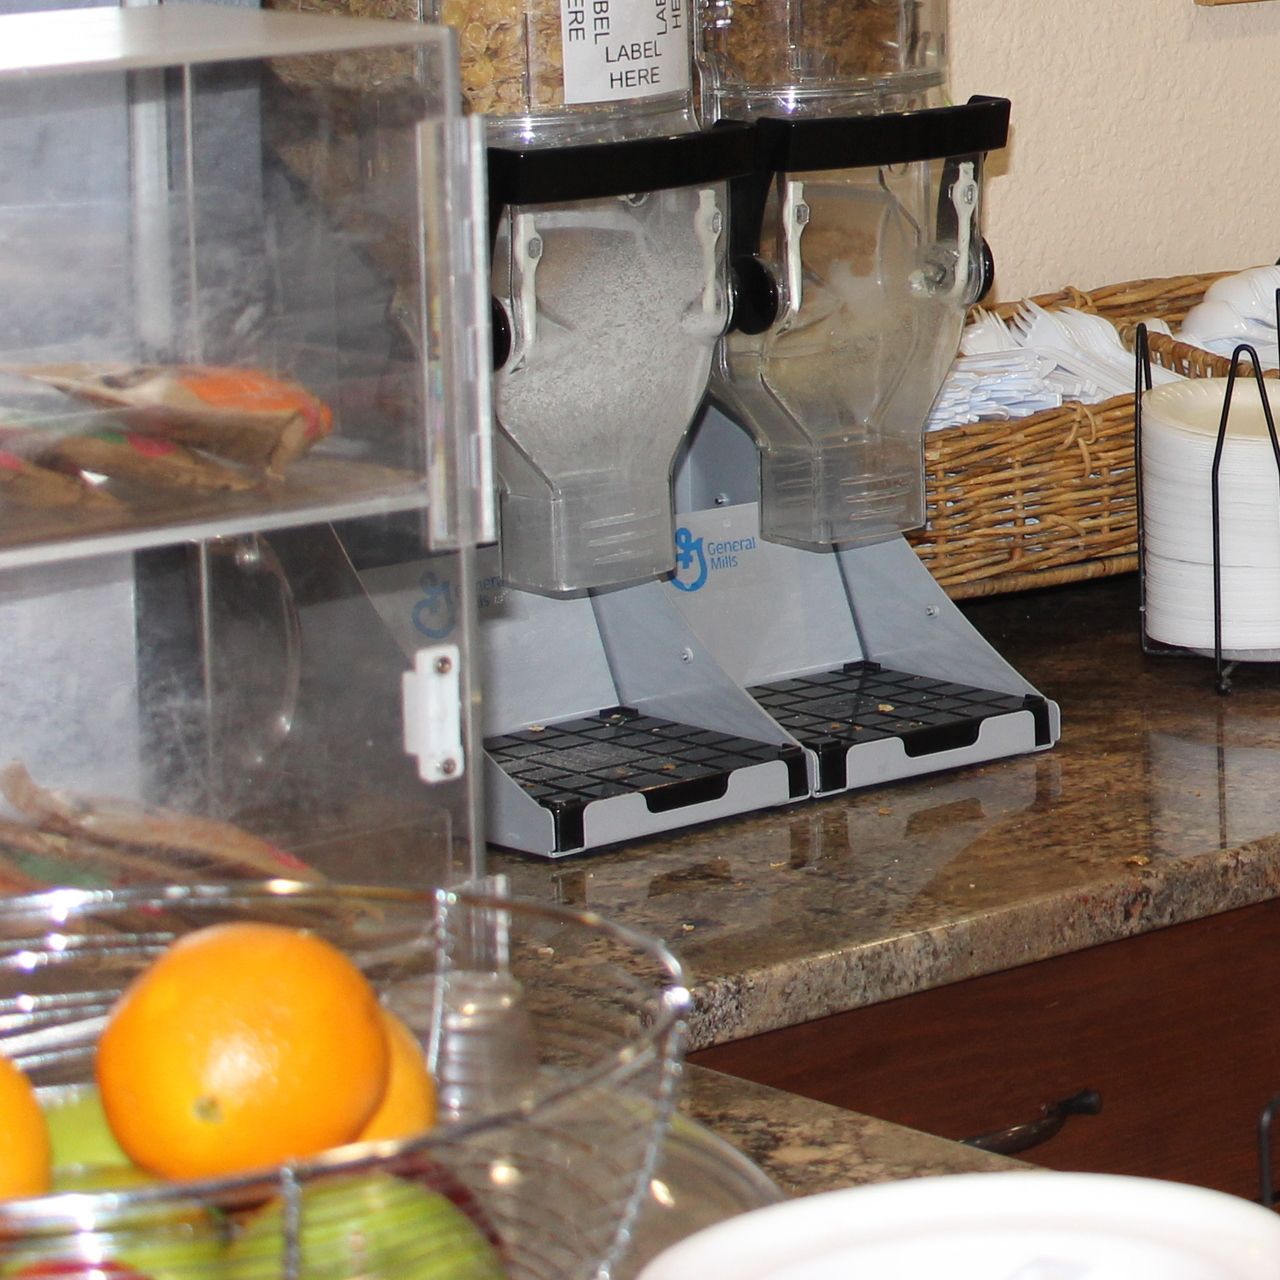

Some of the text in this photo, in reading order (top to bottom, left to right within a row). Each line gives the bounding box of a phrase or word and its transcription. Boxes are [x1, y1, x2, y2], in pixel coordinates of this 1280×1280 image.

[605, 40, 662, 63] LABEL
[610, 66, 661, 89] HERE
[707, 536, 756, 556] General
[710, 554, 738, 570] Mills
